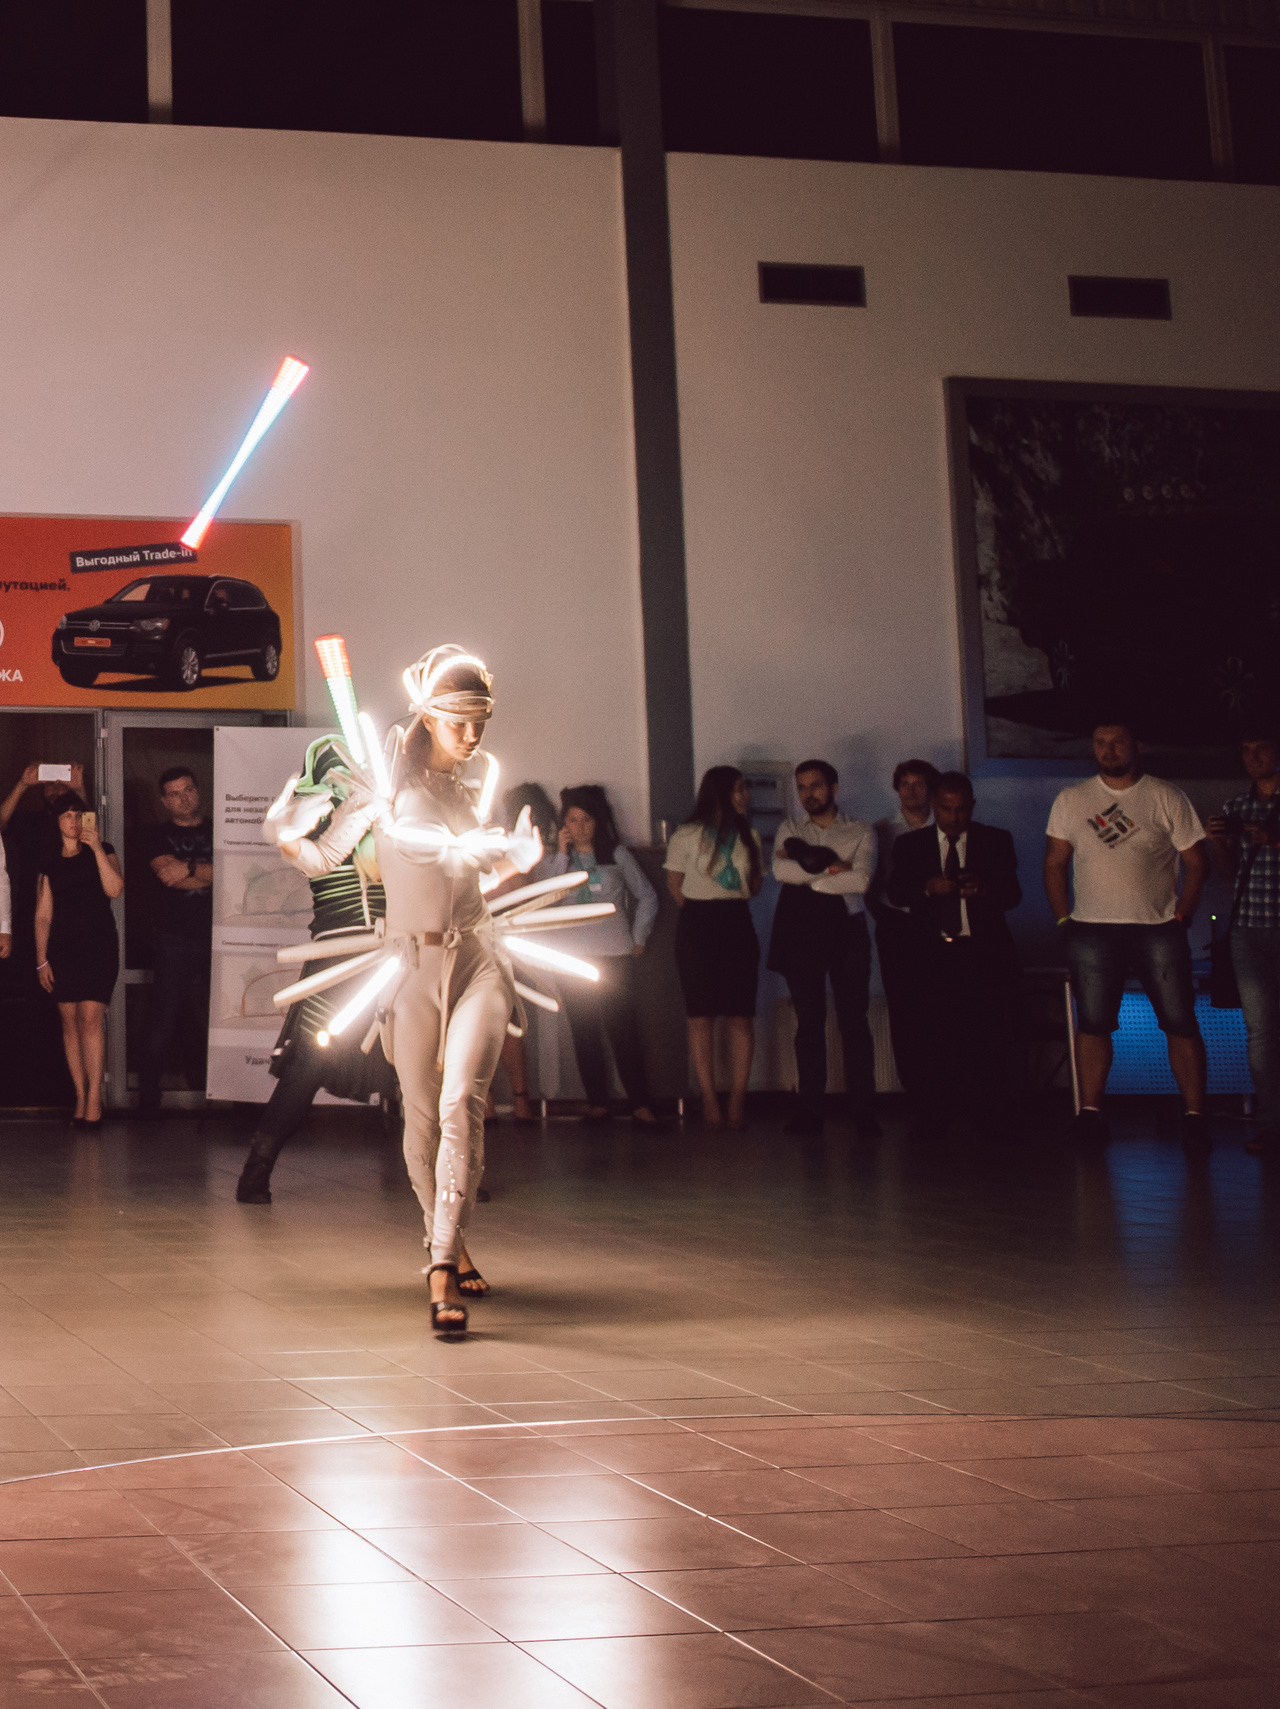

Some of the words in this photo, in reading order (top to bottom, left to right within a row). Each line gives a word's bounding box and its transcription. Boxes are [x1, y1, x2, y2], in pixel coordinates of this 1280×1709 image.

[75, 551, 140, 568] Выгодный
[142, 547, 193, 560] Trade-in
[225, 793, 269, 803] Выберите
